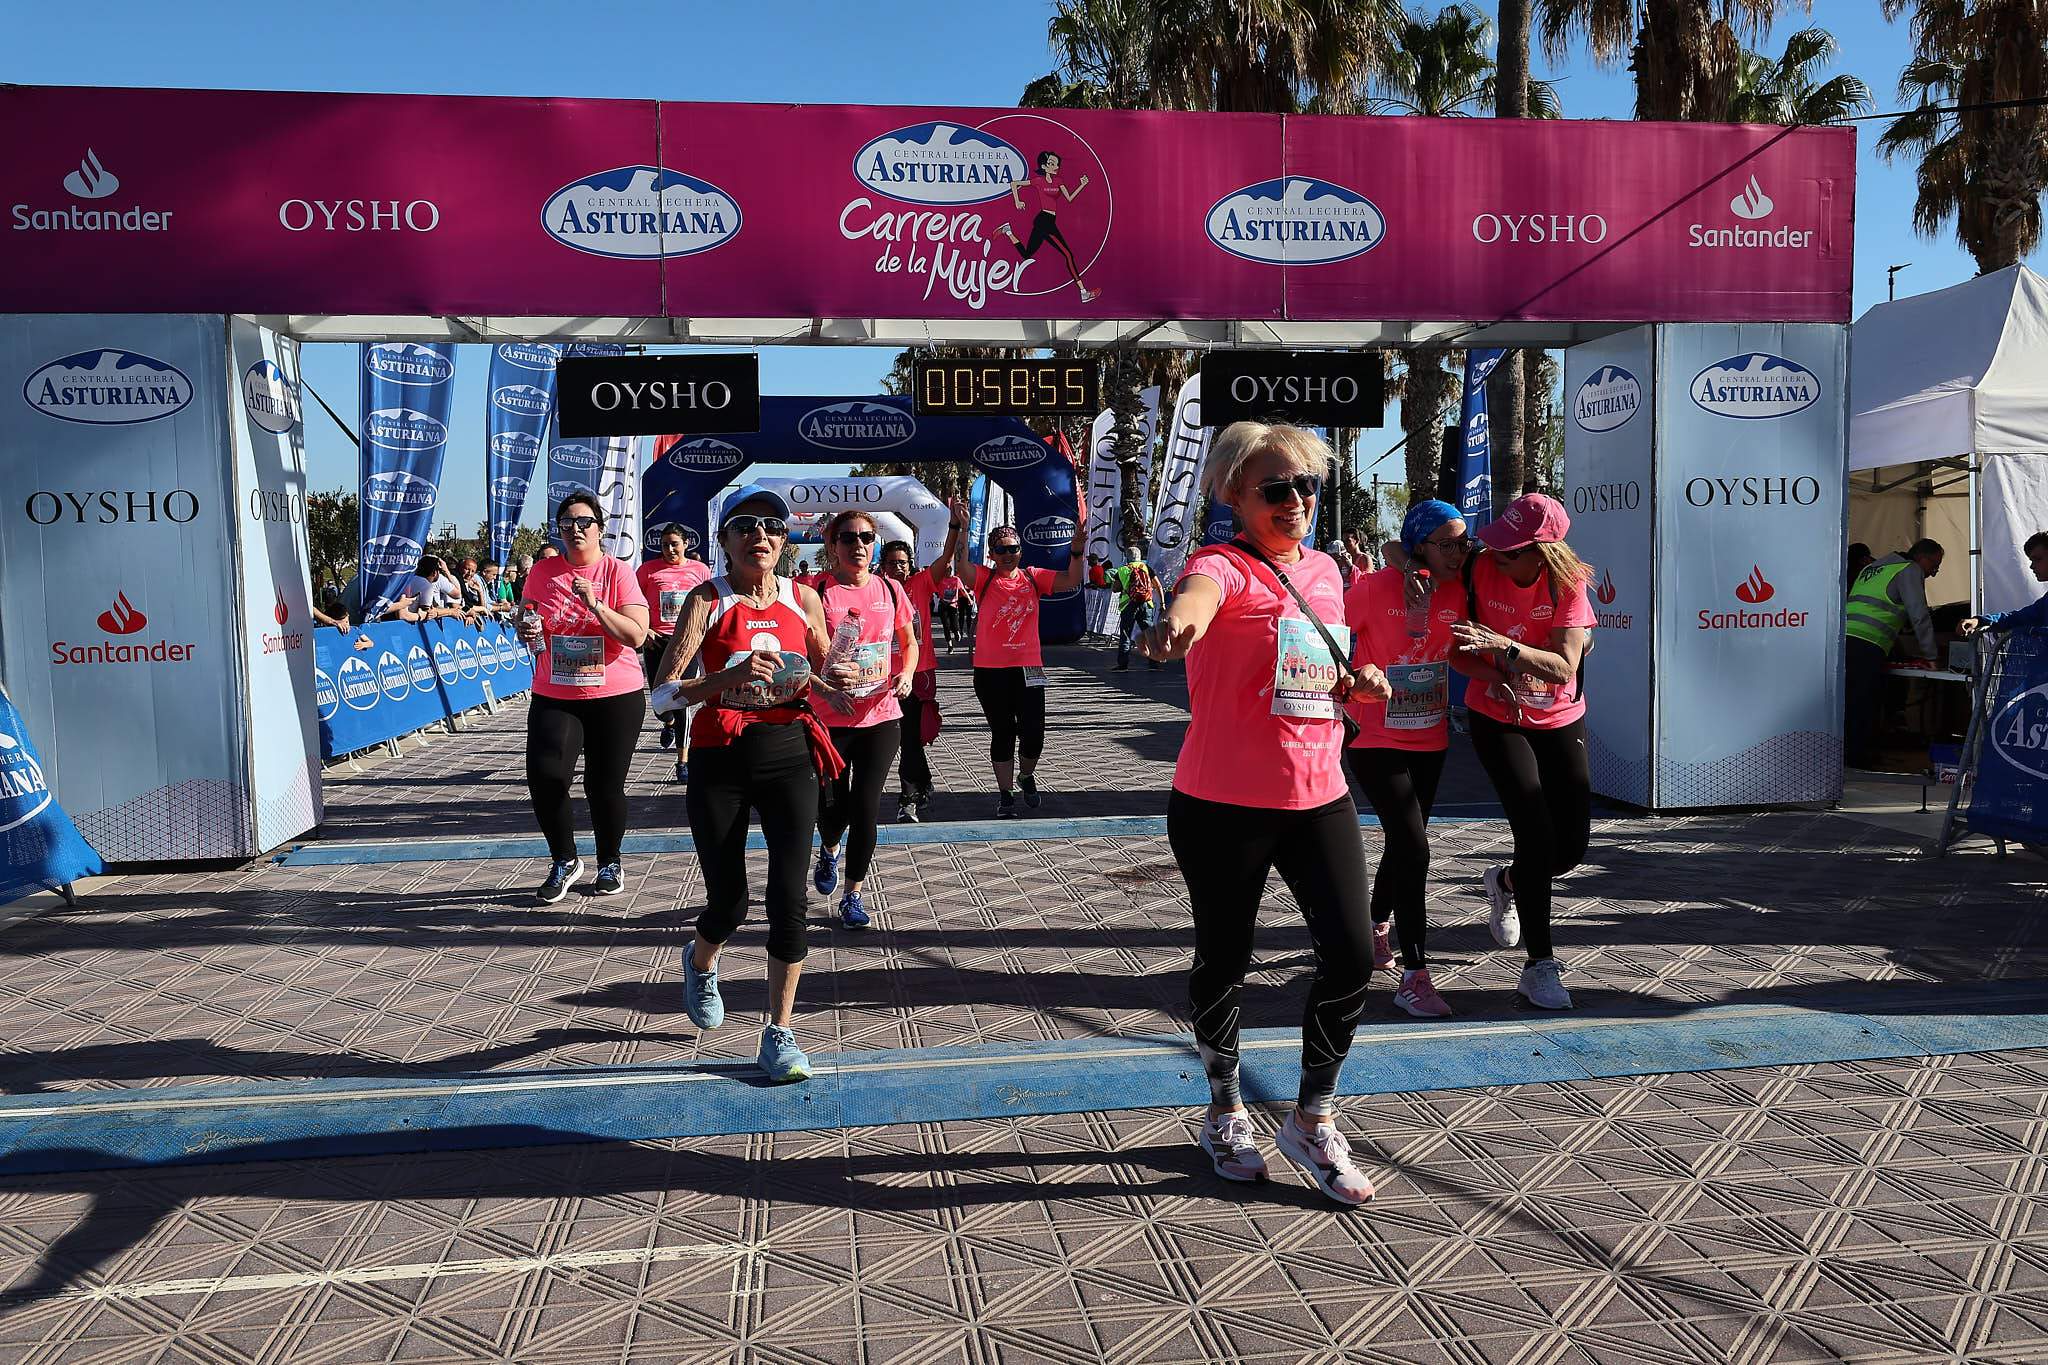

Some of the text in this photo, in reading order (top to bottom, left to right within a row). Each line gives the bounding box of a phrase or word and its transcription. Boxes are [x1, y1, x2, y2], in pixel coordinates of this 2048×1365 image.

[894, 149, 1009, 160] CENTRAL LECHERA
[867, 151, 1014, 185] ASTURIANA
[588, 198, 650, 207] CENTRAL
[1248, 207, 1366, 216] CENTRAL LECHERA
[12, 204, 173, 232] Santander
[279, 199, 440, 233] OYSHO
[558, 200, 727, 235] ASTURIANA
[839, 198, 983, 242] Carrera
[1220, 208, 1372, 242] ASTURIANA
[1472, 213, 1608, 244] OYSHO
[1688, 224, 1813, 249] Santander
[875, 239, 1037, 310] de la Mujer
[370, 352, 447, 378] ASTURIANA
[504, 346, 557, 366] ASTURIAN
[62, 375, 175, 383] CENTRAL LECHERA
[926, 368, 1084, 405] 00:58:55
[1231, 375, 1359, 405] OYSHO
[1700, 377, 1811, 403] ASTURIANA
[1765, 375, 1806, 383] LECHERA
[37, 377, 182, 405] ASTURIANA
[248, 380, 294, 419] ASTURIANA
[497, 391, 548, 411] ASTURIAN
[591, 382, 732, 411] OYSHO
[1578, 392, 1636, 420] ASTURIANA
[368, 421, 441, 443] ASTURIANA
[808, 417, 908, 439] ASTURIANA
[492, 440, 538, 457] ASTURIAN
[554, 450, 599, 467] ASTURIANA
[674, 451, 738, 465] ASTURIANA
[980, 446, 1043, 461] ASTURIANA
[366, 488, 433, 505] ASTURIANA
[790, 484, 883, 504] OYSHO
[1574, 480, 1640, 514] OYSHO
[1685, 476, 1820, 507] OYSHO
[26, 489, 200, 525] OYSHO
[250, 488, 301, 524] OYSHO
[1387, 608, 1407, 617] OYS
[1488, 600, 1515, 615] OYSHO
[1597, 609, 1633, 630] tander
[1698, 608, 1809, 630] Santander
[52, 640, 195, 664] Santander
[262, 632, 303, 654] Santander
[1308, 664, 1336, 681] 016
[1280, 690, 1305, 698] CARRERA
[1305, 691, 1312, 699] DE
[1283, 702, 1315, 712] OYSHO
[1281, 740, 1304, 748] CARRERA
